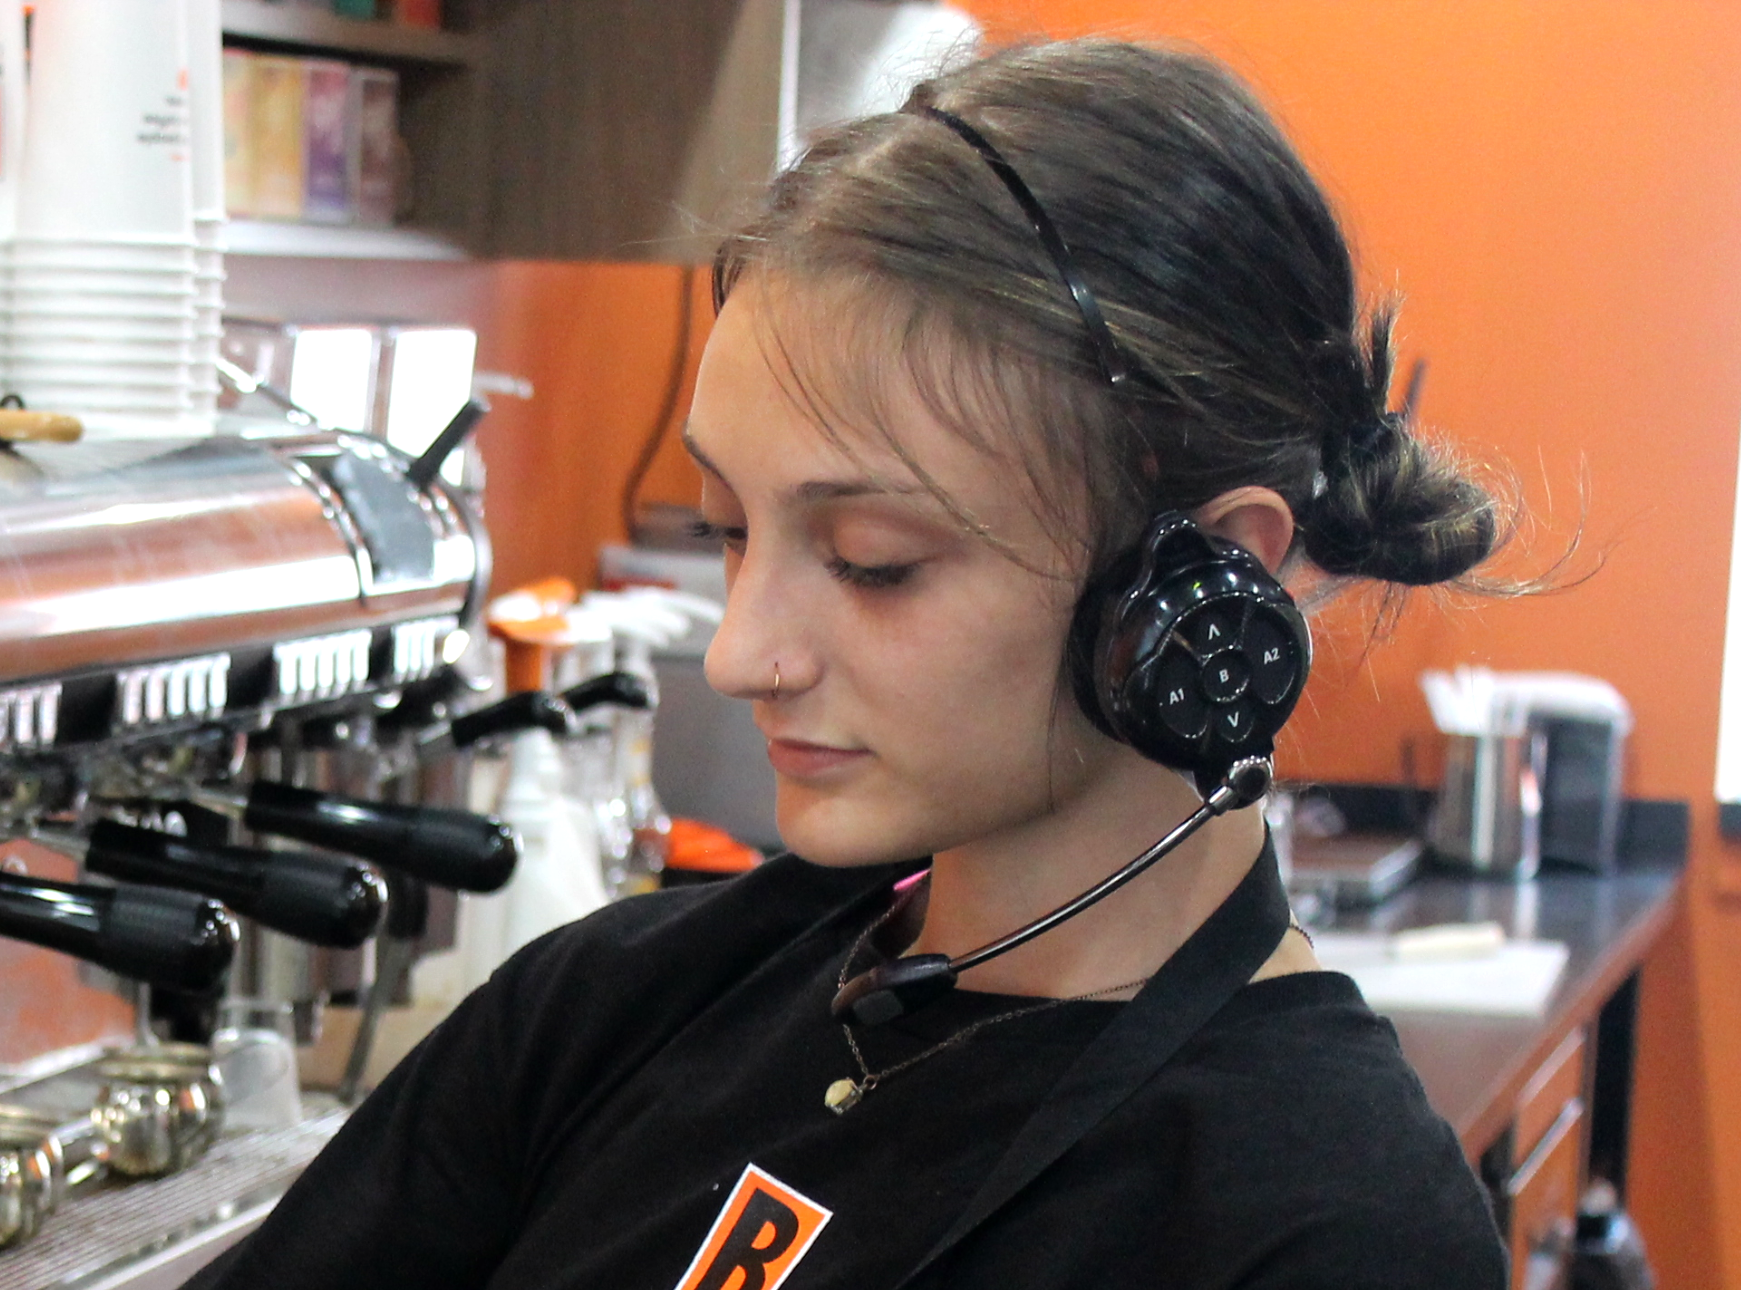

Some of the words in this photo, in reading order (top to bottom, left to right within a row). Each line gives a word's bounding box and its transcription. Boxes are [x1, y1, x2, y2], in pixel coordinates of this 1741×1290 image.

[1263, 647, 1280, 665] A2
[1219, 669, 1229, 682] B
[1168, 688, 1185, 705] A1
